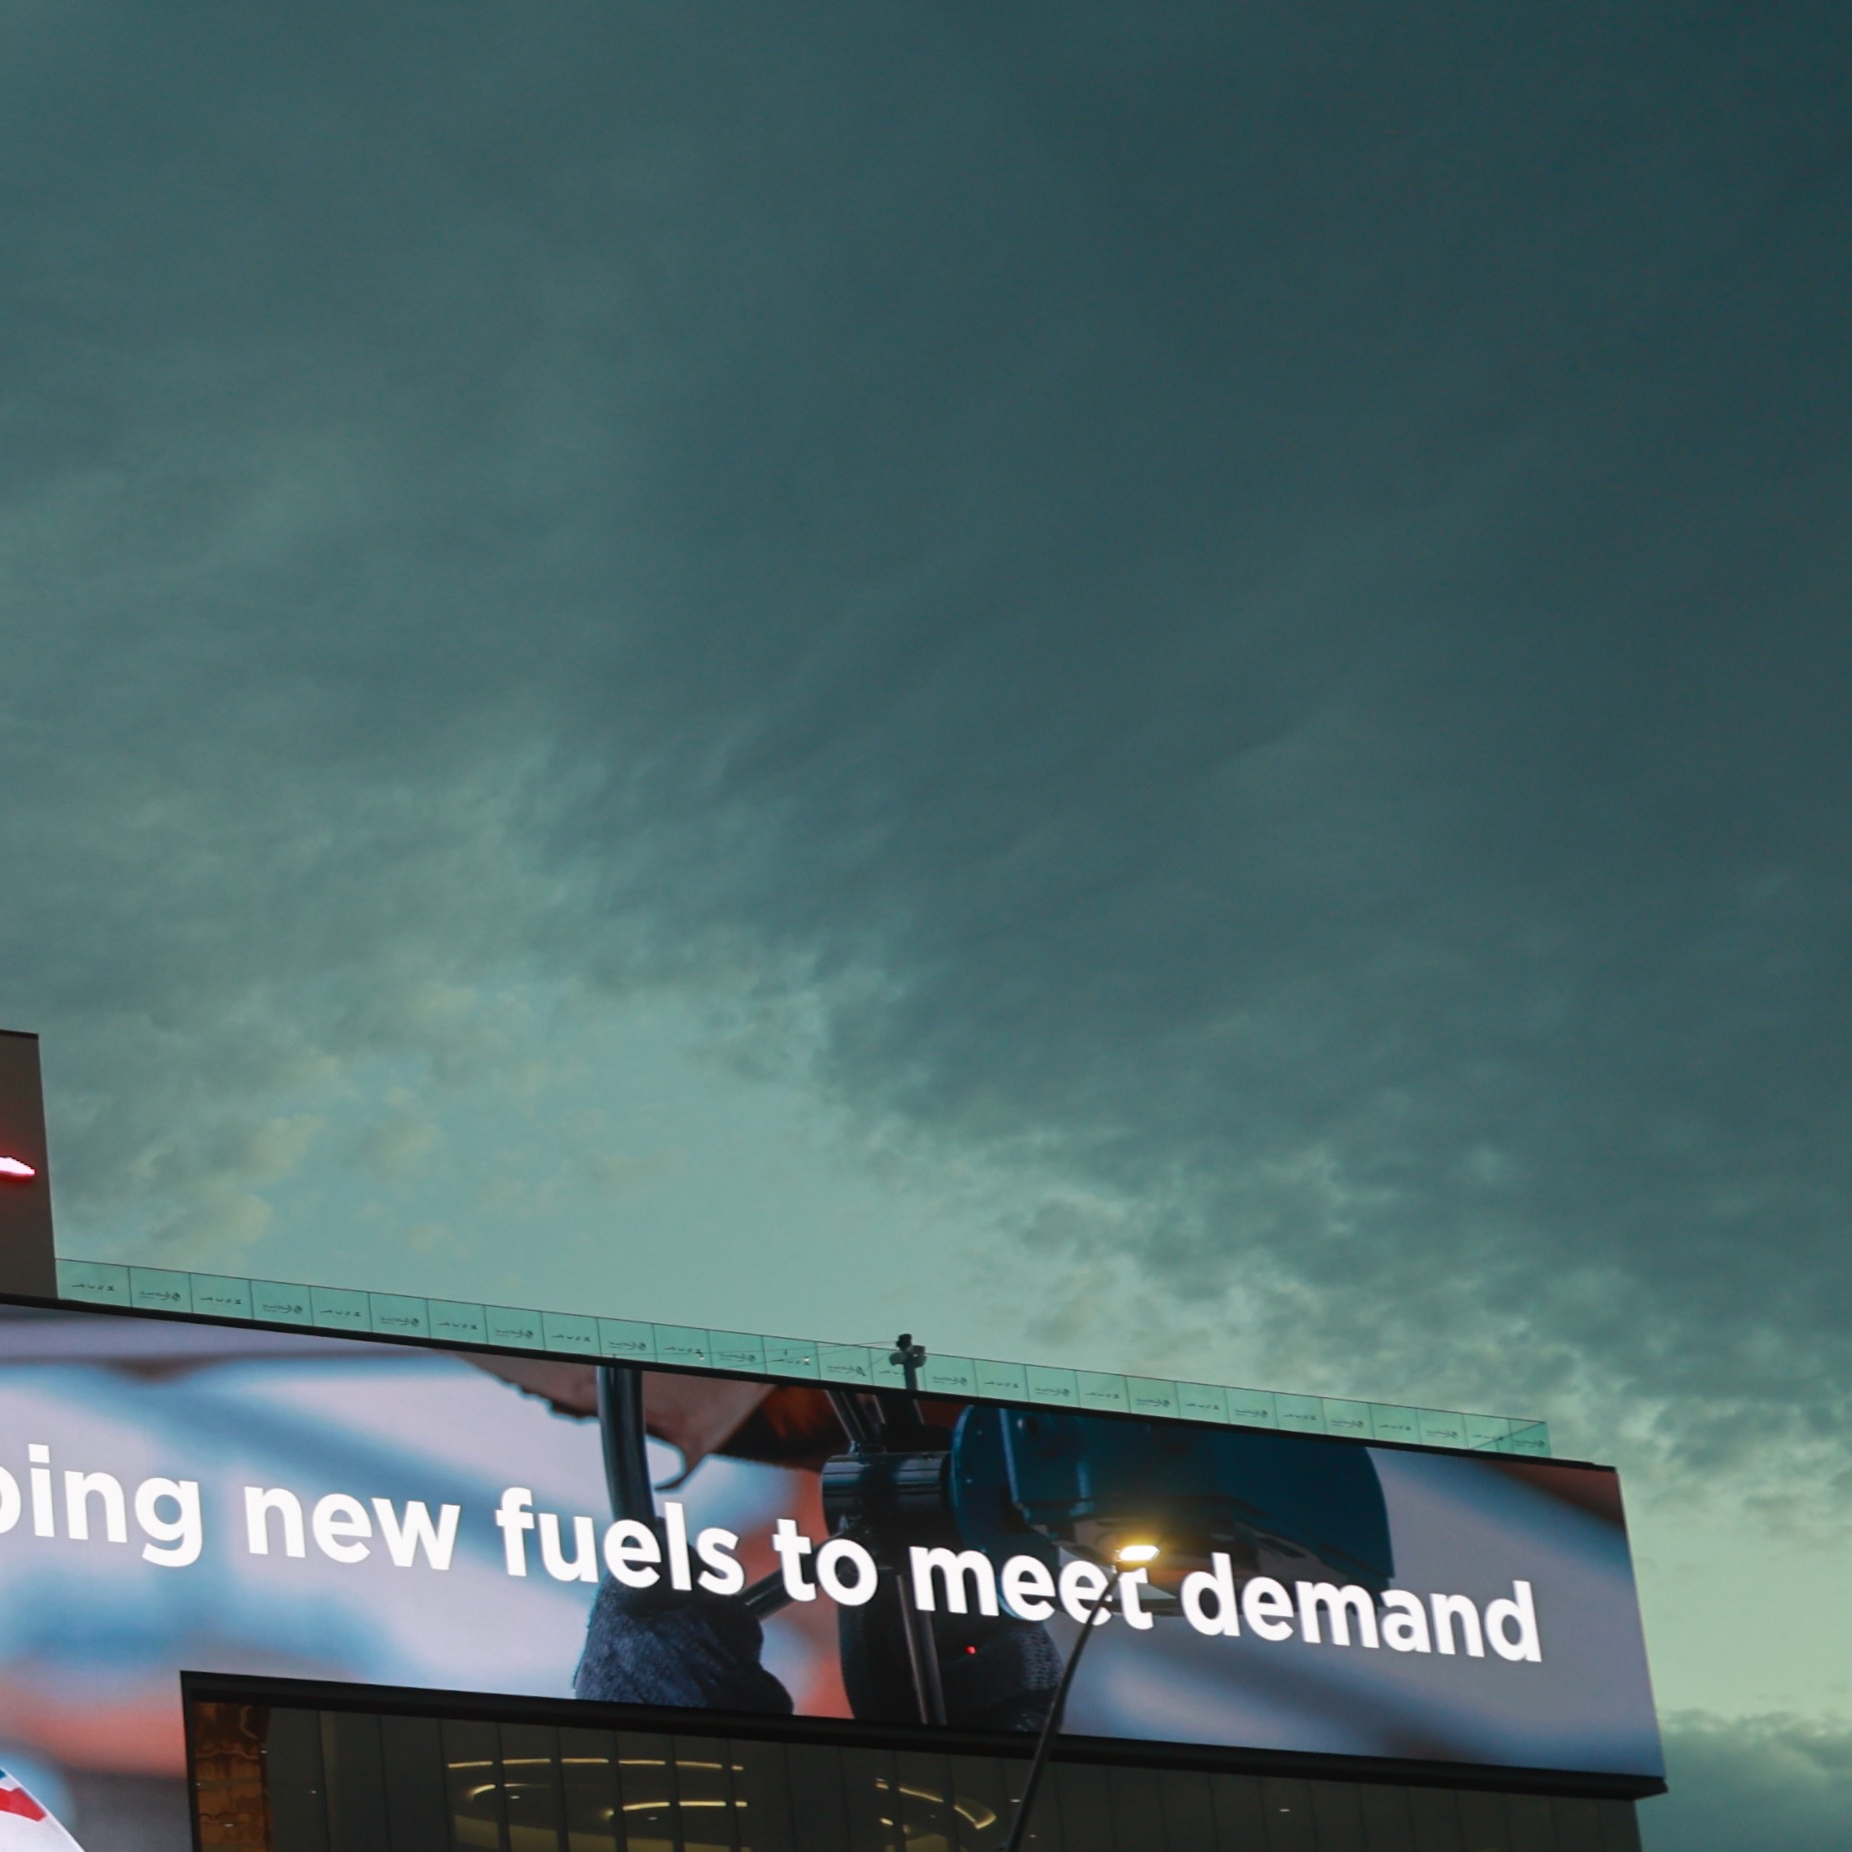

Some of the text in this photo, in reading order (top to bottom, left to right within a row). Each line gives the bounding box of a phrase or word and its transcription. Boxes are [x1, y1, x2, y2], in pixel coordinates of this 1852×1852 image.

[243, 1485, 462, 1573] new
[495, 1486, 745, 1596] fuels
[772, 1518, 880, 1607] to
[909, 1545, 1155, 1631] meet
[1181, 1552, 1542, 1663] demand
